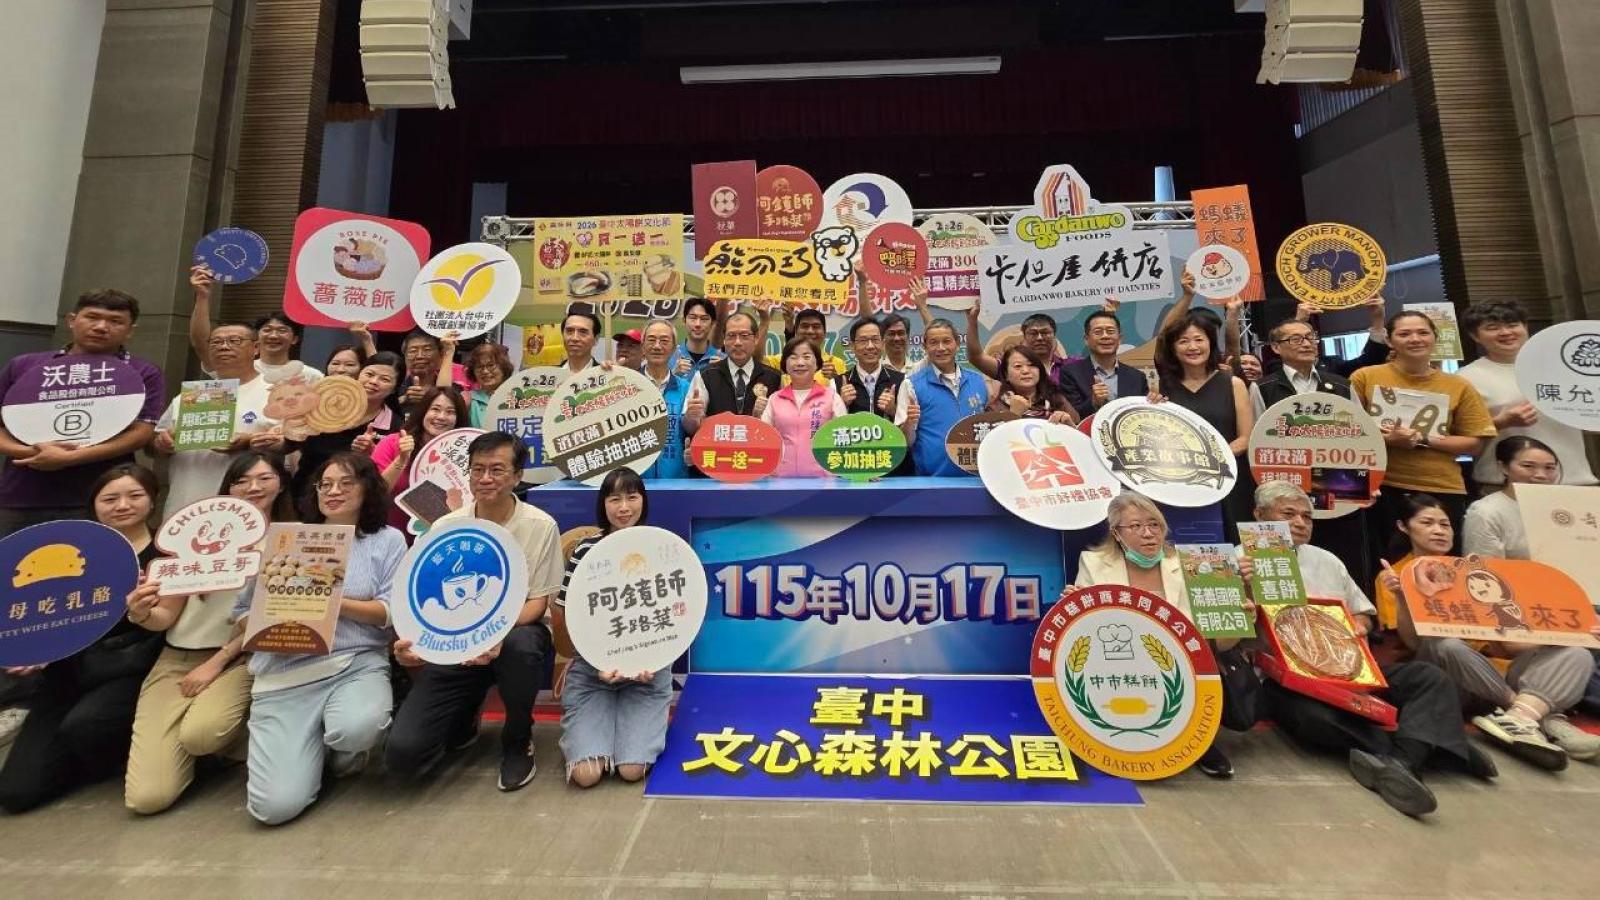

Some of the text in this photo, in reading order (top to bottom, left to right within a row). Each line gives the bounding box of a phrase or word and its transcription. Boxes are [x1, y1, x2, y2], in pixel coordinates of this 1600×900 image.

[1199, 202, 1248, 225] 螞蟻
[577, 221, 597, 230] 2026
[1016, 212, 1126, 248] Cardanwo
[1065, 231, 1112, 242] FOODS
[1203, 227, 1247, 246] 來了
[1278, 226, 1382, 297] ENOCH GROWER MANOR
[1012, 282, 1161, 304] CARDANWO BAKERY OF DAINTIES
[41, 361, 116, 387] 沃農士
[522, 374, 556, 387] 2026
[570, 375, 607, 394] 2026
[38, 385, 116, 401] 食品股份有限公司
[1535, 383, 1600, 404] 陳允
[1293, 402, 1332, 415] 2026
[64, 414, 82, 431] B
[497, 415, 543, 437] 限定
[714, 424, 748, 442] 限量
[557, 424, 601, 451] 消費滿
[832, 424, 883, 446] 滿500
[567, 428, 660, 478] 體驗抽抽樂
[702, 450, 764, 470] 買一送一
[827, 449, 893, 471] 參加抽獎
[1259, 448, 1377, 466] 消費滿 500元
[157, 557, 252, 578] 辣味豆哥
[1254, 556, 1293, 578] 雅富
[586, 568, 686, 616] 阿鏡師
[715, 563, 1042, 622] 115年10月17日
[1259, 578, 1299, 600] 喜餅
[9, 586, 111, 619] 母吃乳酪
[22, 622, 49, 634] WIFE
[71, 610, 110, 624] CHEESE
[608, 606, 675, 638] 手路菜
[1038, 590, 1201, 662] 臺中市糕餅商業同業公會
[1195, 612, 1248, 631] 有限公司
[1529, 603, 1582, 629] 來了
[417, 615, 508, 652] Bluesky Coffee
[1090, 674, 1159, 691] 中市糕餅
[809, 686, 924, 726] 臺中
[1044, 694, 1216, 773] TAICHUNG BAKERY ASSOCIATION
[682, 727, 1080, 781] 文心森林公園
